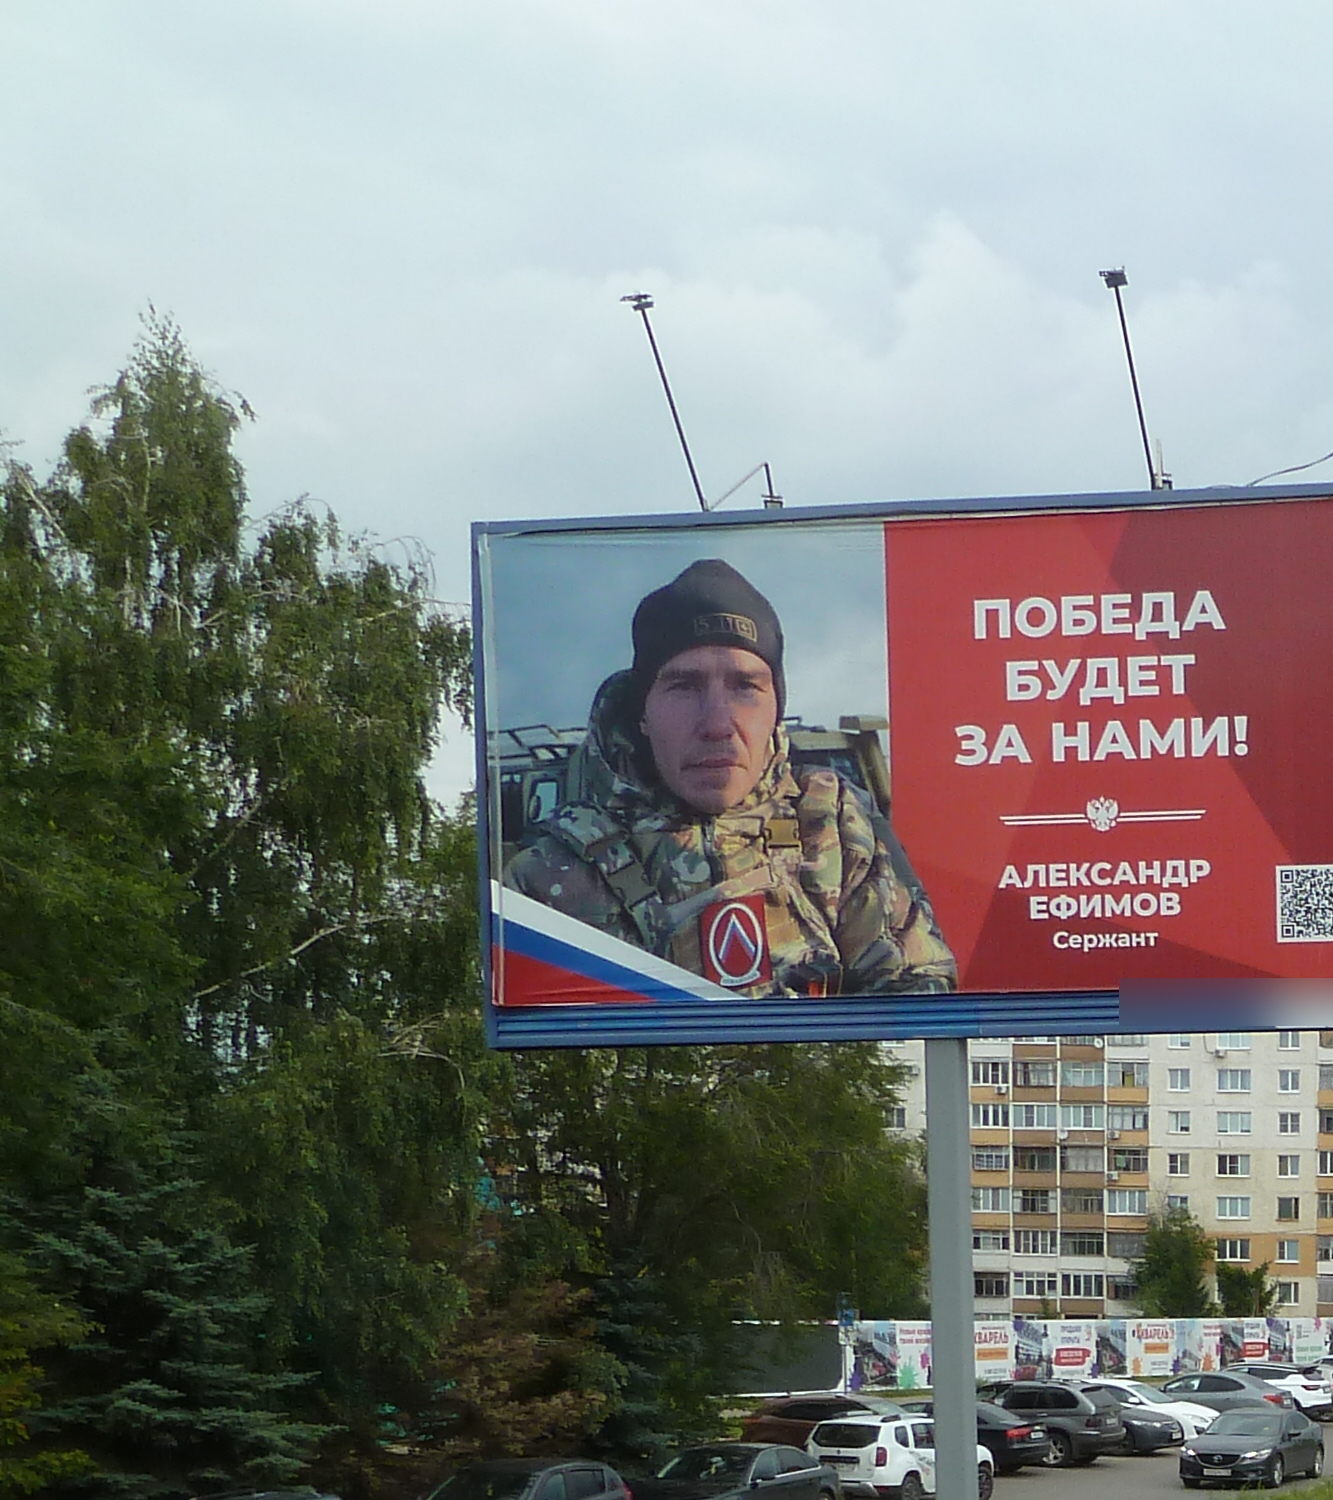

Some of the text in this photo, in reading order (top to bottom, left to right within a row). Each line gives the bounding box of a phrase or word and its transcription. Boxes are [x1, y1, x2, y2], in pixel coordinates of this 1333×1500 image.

[973, 590, 1227, 640] ПОБЕДА
[1005, 653, 1196, 706] БУДЕТ
[953, 715, 1249, 766] ЗА НАМИ!
[998, 858, 1211, 889] АЛЕКСАНДР
[1029, 891, 1182, 920] ЕФИМОВ
[1052, 930, 1159, 952] Сержант
